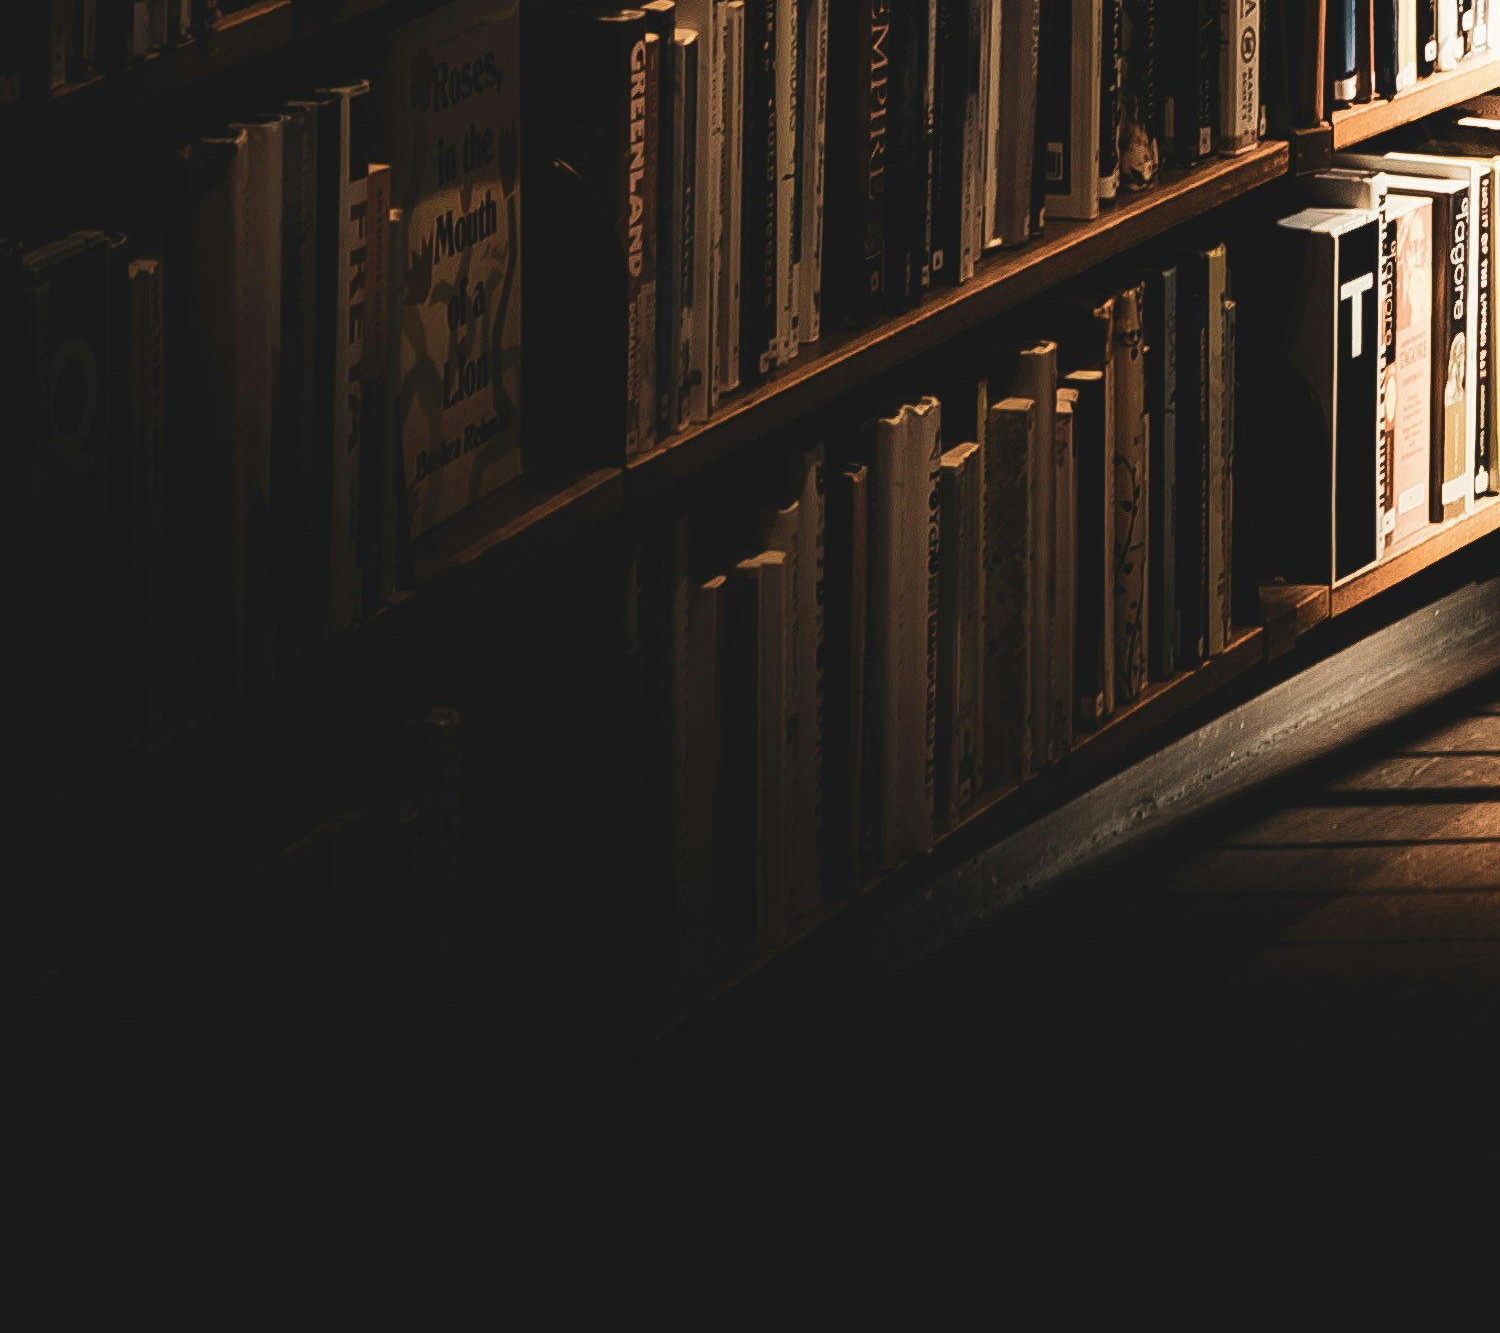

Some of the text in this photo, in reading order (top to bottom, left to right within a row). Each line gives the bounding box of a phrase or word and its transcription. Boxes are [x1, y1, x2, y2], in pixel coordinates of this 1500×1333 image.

[431, 49, 502, 113] Roses,
[1031, 26, 1039, 79] DONE
[437, 122, 494, 187] in the
[627, 39, 646, 279] GREENLAND
[431, 198, 498, 264] Mouth
[447, 276, 486, 334] of a
[1338, 270, 1375, 360] T
[441, 346, 489, 411] Lion
[626, 301, 636, 404] DONALDSON
